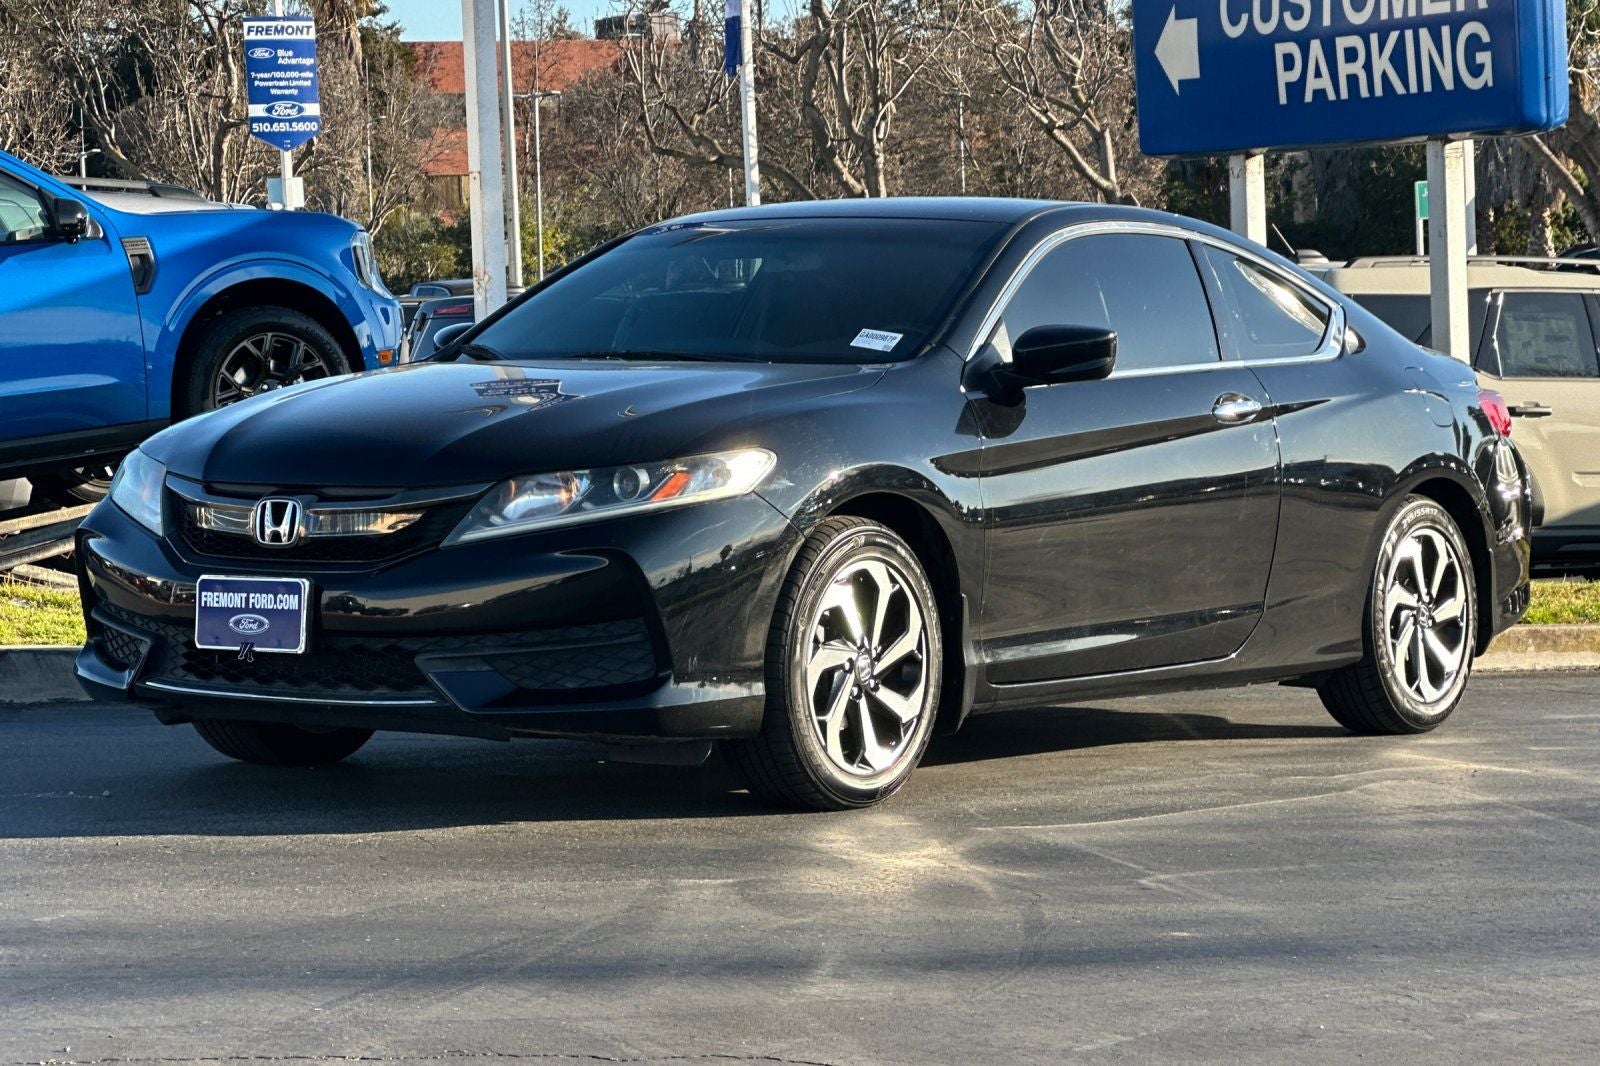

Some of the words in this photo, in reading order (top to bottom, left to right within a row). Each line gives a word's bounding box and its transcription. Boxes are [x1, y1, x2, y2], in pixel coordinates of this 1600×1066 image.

[247, 25, 313, 36] FREMONT
[277, 49, 293, 57] Blue
[278, 57, 315, 66] Advantage
[1274, 21, 1493, 105] PARKING
[251, 71, 314, 79] 7-year/100,000-mile
[272, 103, 299, 116] Ford
[252, 121, 318, 132] 510.651.5600
[201, 591, 247, 608] FREMONT
[249, 593, 299, 610] FORD.COM
[238, 618, 258, 631] Ford
